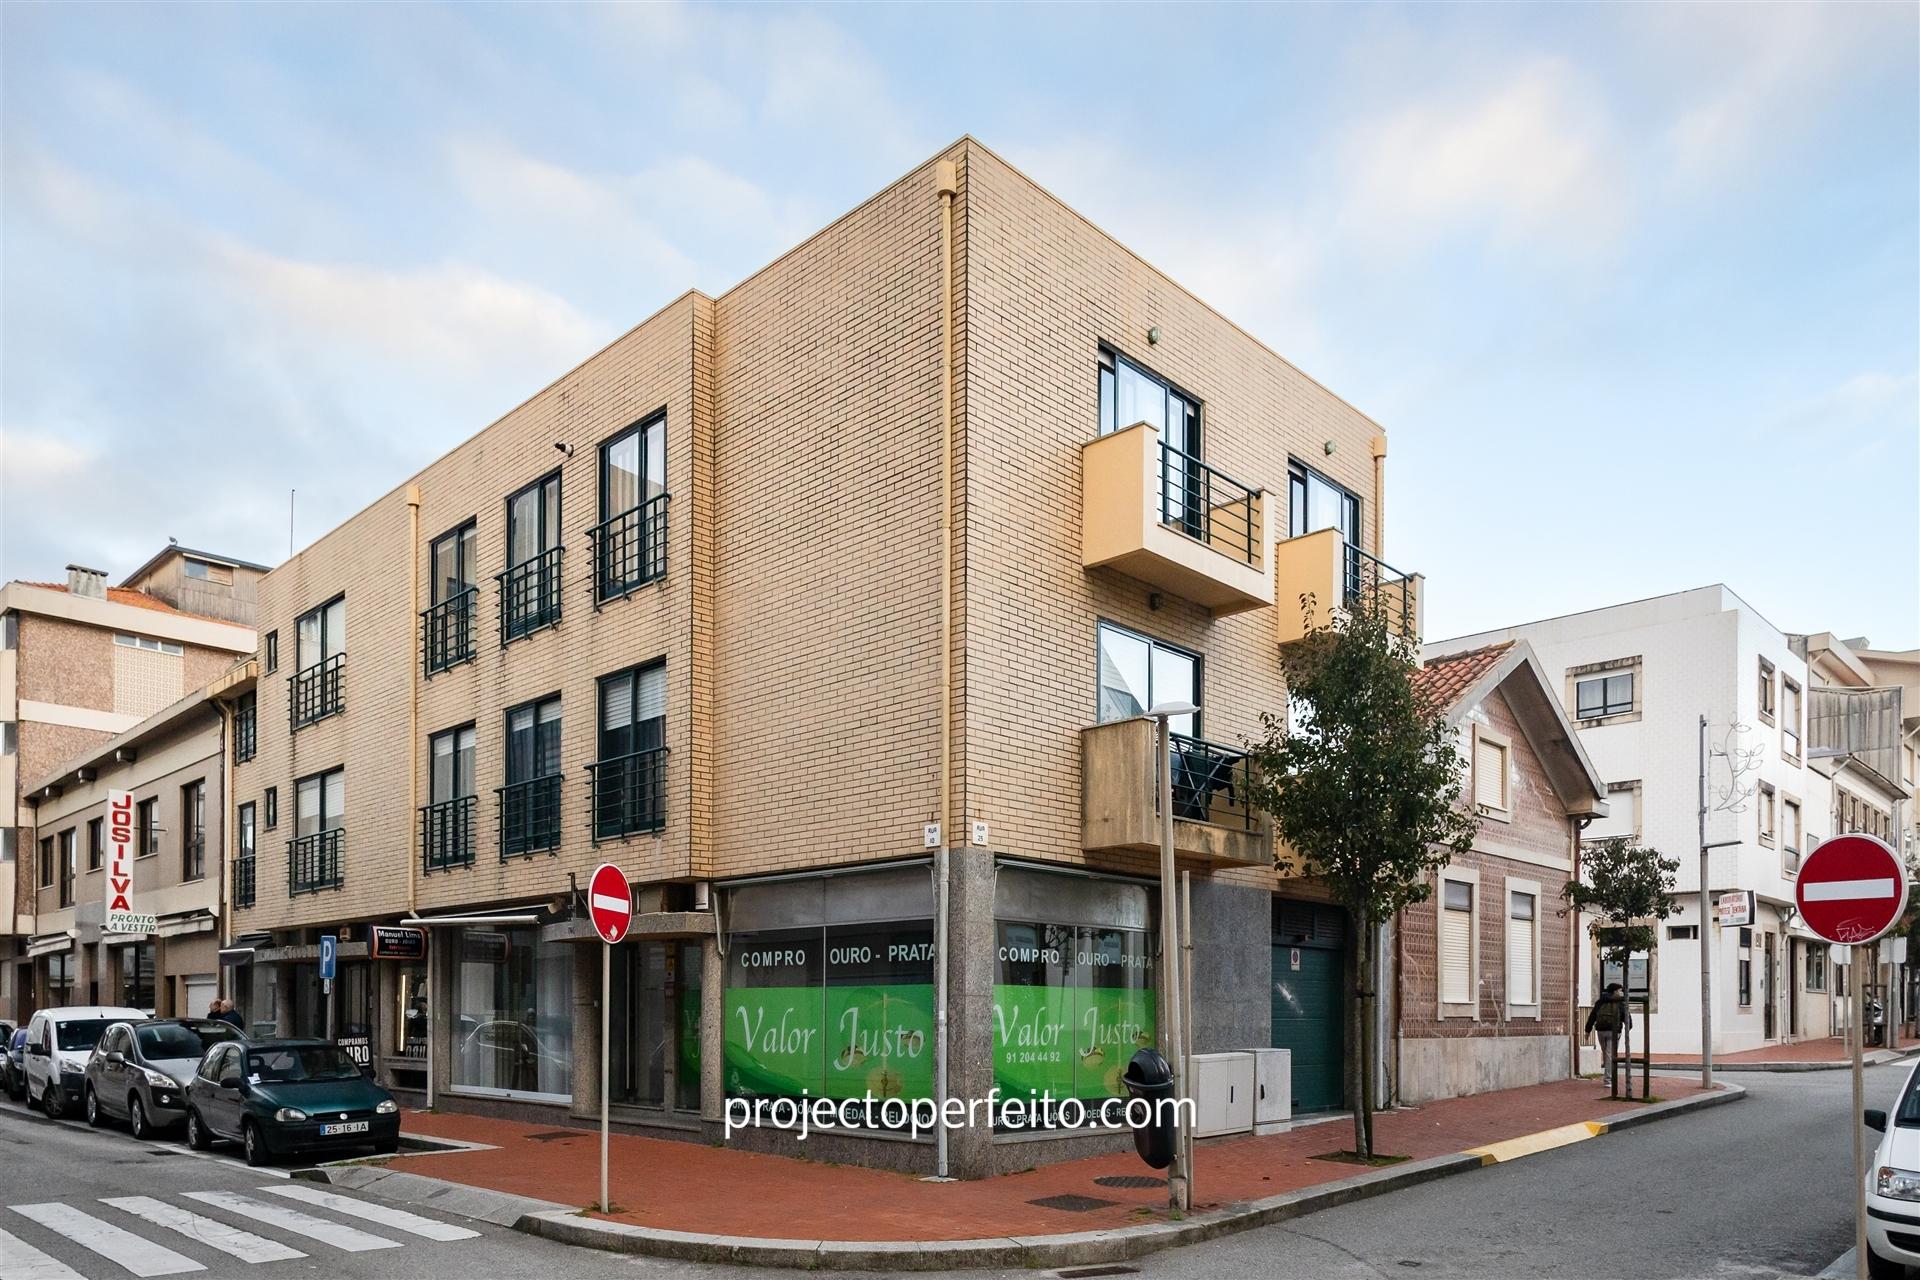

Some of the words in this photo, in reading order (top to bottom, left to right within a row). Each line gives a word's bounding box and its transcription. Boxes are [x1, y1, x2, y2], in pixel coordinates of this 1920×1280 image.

[110, 795, 132, 911] JOSILVA
[110, 914, 155, 924] PRONTO
[110, 923, 119, 931] A
[121, 923, 157, 933] VESTIR
[378, 930, 404, 938] Manuel
[322, 941, 332, 974] P
[741, 950, 806, 968] COMPRO
[830, 946, 871, 964] OURO
[888, 944, 935, 962] PRATA
[999, 946, 1060, 964] COMPRO
[1078, 951, 1110, 967] OURO
[1121, 954, 1153, 969] PRATA
[337, 1037, 369, 1046] COMPRAMOS
[735, 1005, 816, 1055] Valor
[833, 1007, 925, 1071] Justo
[992, 1004, 1065, 1048] Valor
[1079, 1006, 1142, 1057] Justo
[1006, 1052, 1017, 1063] 91
[1019, 1052, 1036, 1063] 204
[1037, 1052, 1048, 1063] 44
[1050, 1052, 1060, 1062] 92
